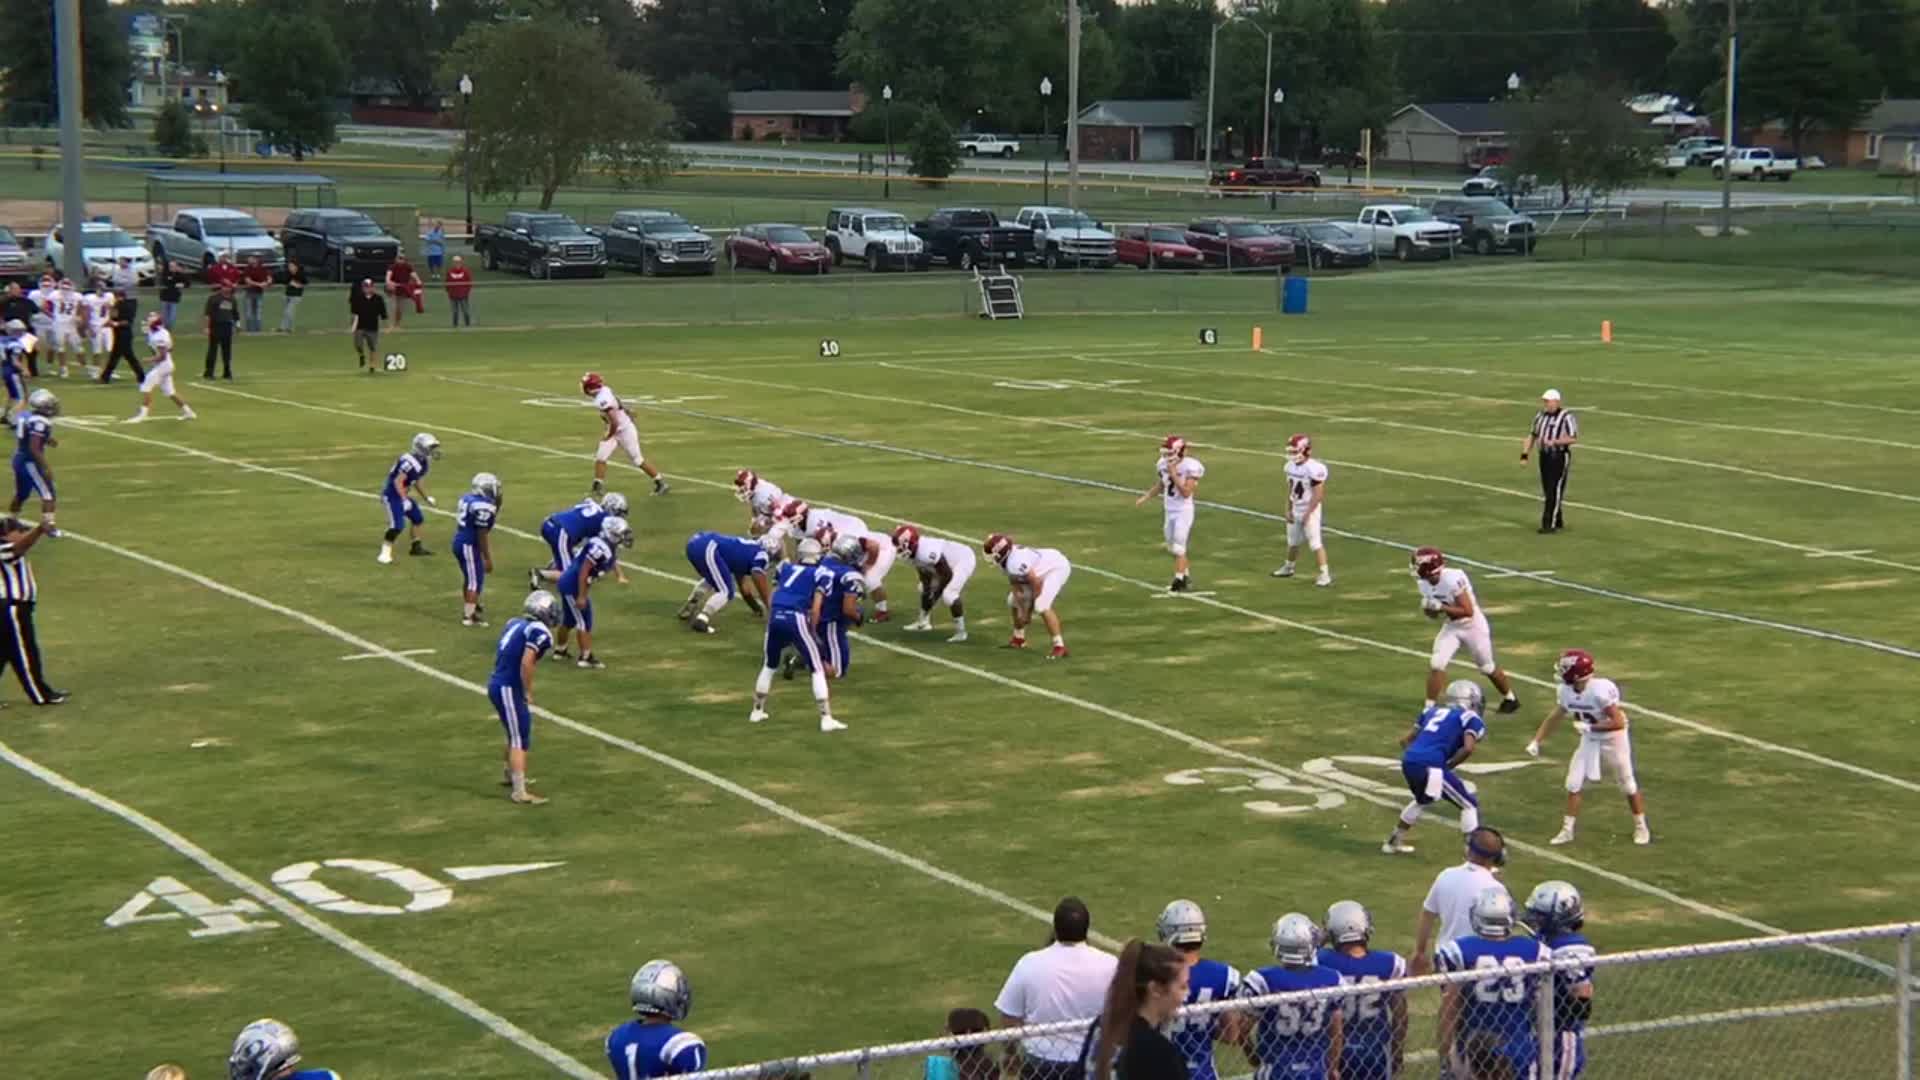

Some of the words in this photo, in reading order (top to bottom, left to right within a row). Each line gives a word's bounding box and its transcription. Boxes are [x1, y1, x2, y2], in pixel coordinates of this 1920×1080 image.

[821, 340, 839, 356] 10
[1204, 329, 1215, 344] G
[386, 353, 406, 371] 20
[783, 565, 807, 588] 7
[1424, 708, 1451, 733] 2
[104, 858, 453, 938] 40
[1474, 955, 1526, 1003] 23
[1277, 998, 1327, 1037] 53
[624, 1042, 639, 1080] 1
